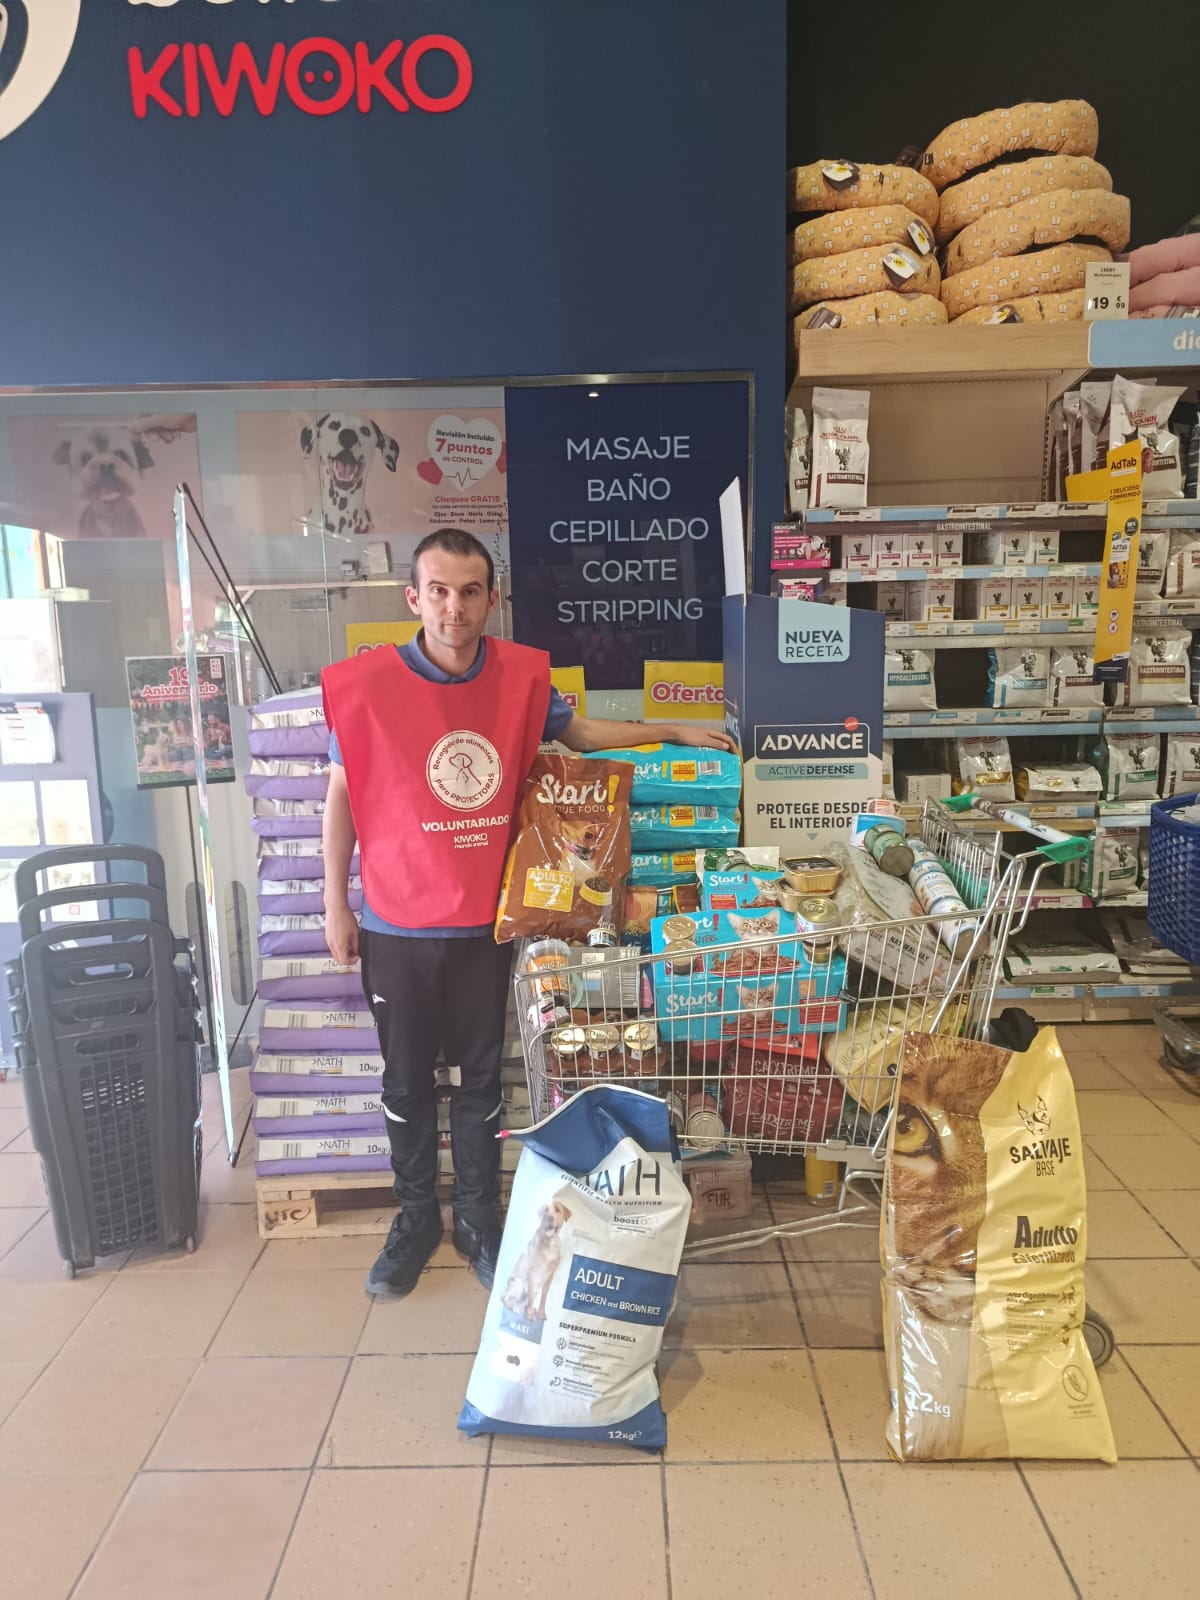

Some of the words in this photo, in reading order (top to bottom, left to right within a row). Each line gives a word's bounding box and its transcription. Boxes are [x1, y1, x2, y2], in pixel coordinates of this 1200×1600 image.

[128, 34, 473, 118] KIWOKO
[1092, 296, 1110, 310] 19
[436, 429, 466, 439] Revisión
[435, 438, 447, 452] 7
[447, 443, 493, 456] puntos
[566, 436, 692, 461] MASAJE
[452, 457, 483, 465] CONTROL
[1110, 457, 1137, 470] AdTab
[587, 472, 672, 502] BAÑO
[1113, 484, 1140, 494] DELICIOSO
[470, 495, 501, 503] GRATIS
[549, 518, 710, 544] CEPILLADO
[582, 559, 678, 583] CORTE
[557, 598, 704, 623] STRIPPING
[785, 630, 844, 644] NUEVA
[785, 645, 843, 658] RECETA
[761, 733, 864, 751] ADVANCE
[466, 738, 494, 764] alimentos
[435, 778, 450, 796] para
[450, 772, 495, 803] PROTECTORAS
[578, 804, 605, 814] FOOD
[757, 803, 820, 815] PROTEGE
[823, 802, 868, 815] DESDE
[421, 814, 510, 832] VOLUNTARIADO
[770, 818, 787, 829] EL
[454, 833, 488, 844] KIWOKO
[329, 1013, 356, 1022] NATH
[316, 1057, 343, 1067] NATH
[320, 1098, 346, 1108] NATH
[324, 1139, 350, 1149] NATH
[1009, 1137, 1072, 1164] SALVAJE
[1036, 1162, 1056, 1177] BASE
[560, 1174, 595, 1198] SCIENTIFIC
[1014, 1215, 1078, 1249] Adulto
[574, 1267, 625, 1292] ADULT
[570, 1290, 607, 1307] CHICKEN
[607, 1301, 619, 1309] and
[619, 1301, 648, 1314] BROWN
[647, 1305, 662, 1316] RICE
[509, 1321, 530, 1335] MAXI
[559, 1322, 608, 1338] SUPERPREMIUM
[608, 1332, 637, 1343] FORMULA
